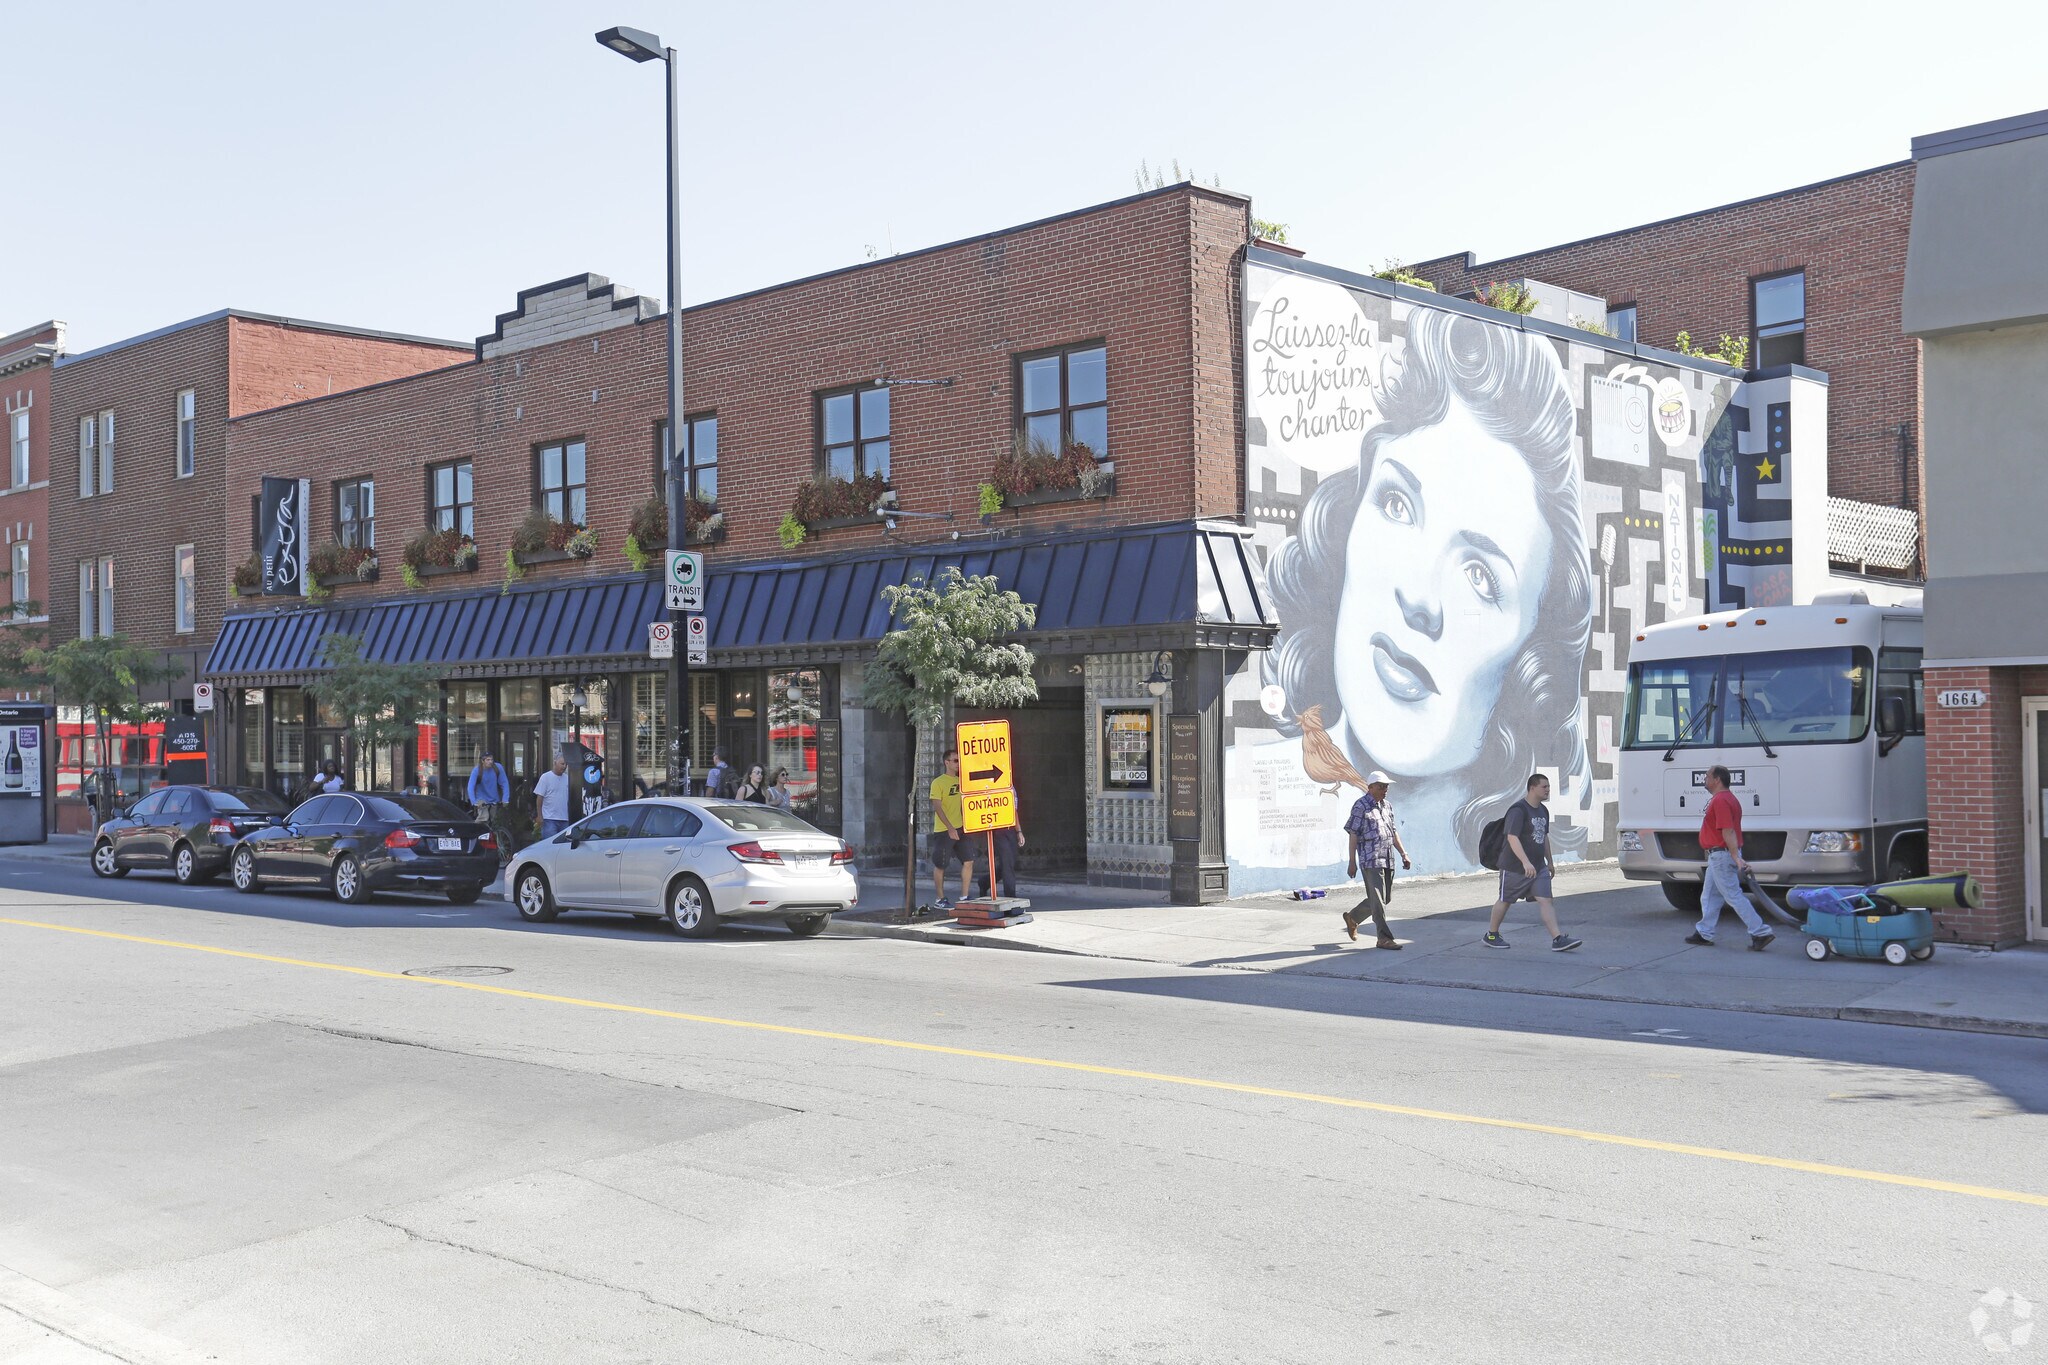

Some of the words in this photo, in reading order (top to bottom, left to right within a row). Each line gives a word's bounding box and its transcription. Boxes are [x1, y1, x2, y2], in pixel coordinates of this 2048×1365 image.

[1252, 296, 1373, 366] Laissez-la
[1256, 355, 1372, 411] toujours
[1279, 395, 1374, 443] chanter
[1669, 493, 1682, 602] NATIONAL
[668, 584, 701, 596] TRANSIT
[1752, 568, 1788, 598] CASA
[1945, 692, 1978, 706] 1664
[963, 736, 1006, 756] DÉTOUR
[967, 796, 1009, 811] ONTARIO
[980, 812, 999, 825] EST
